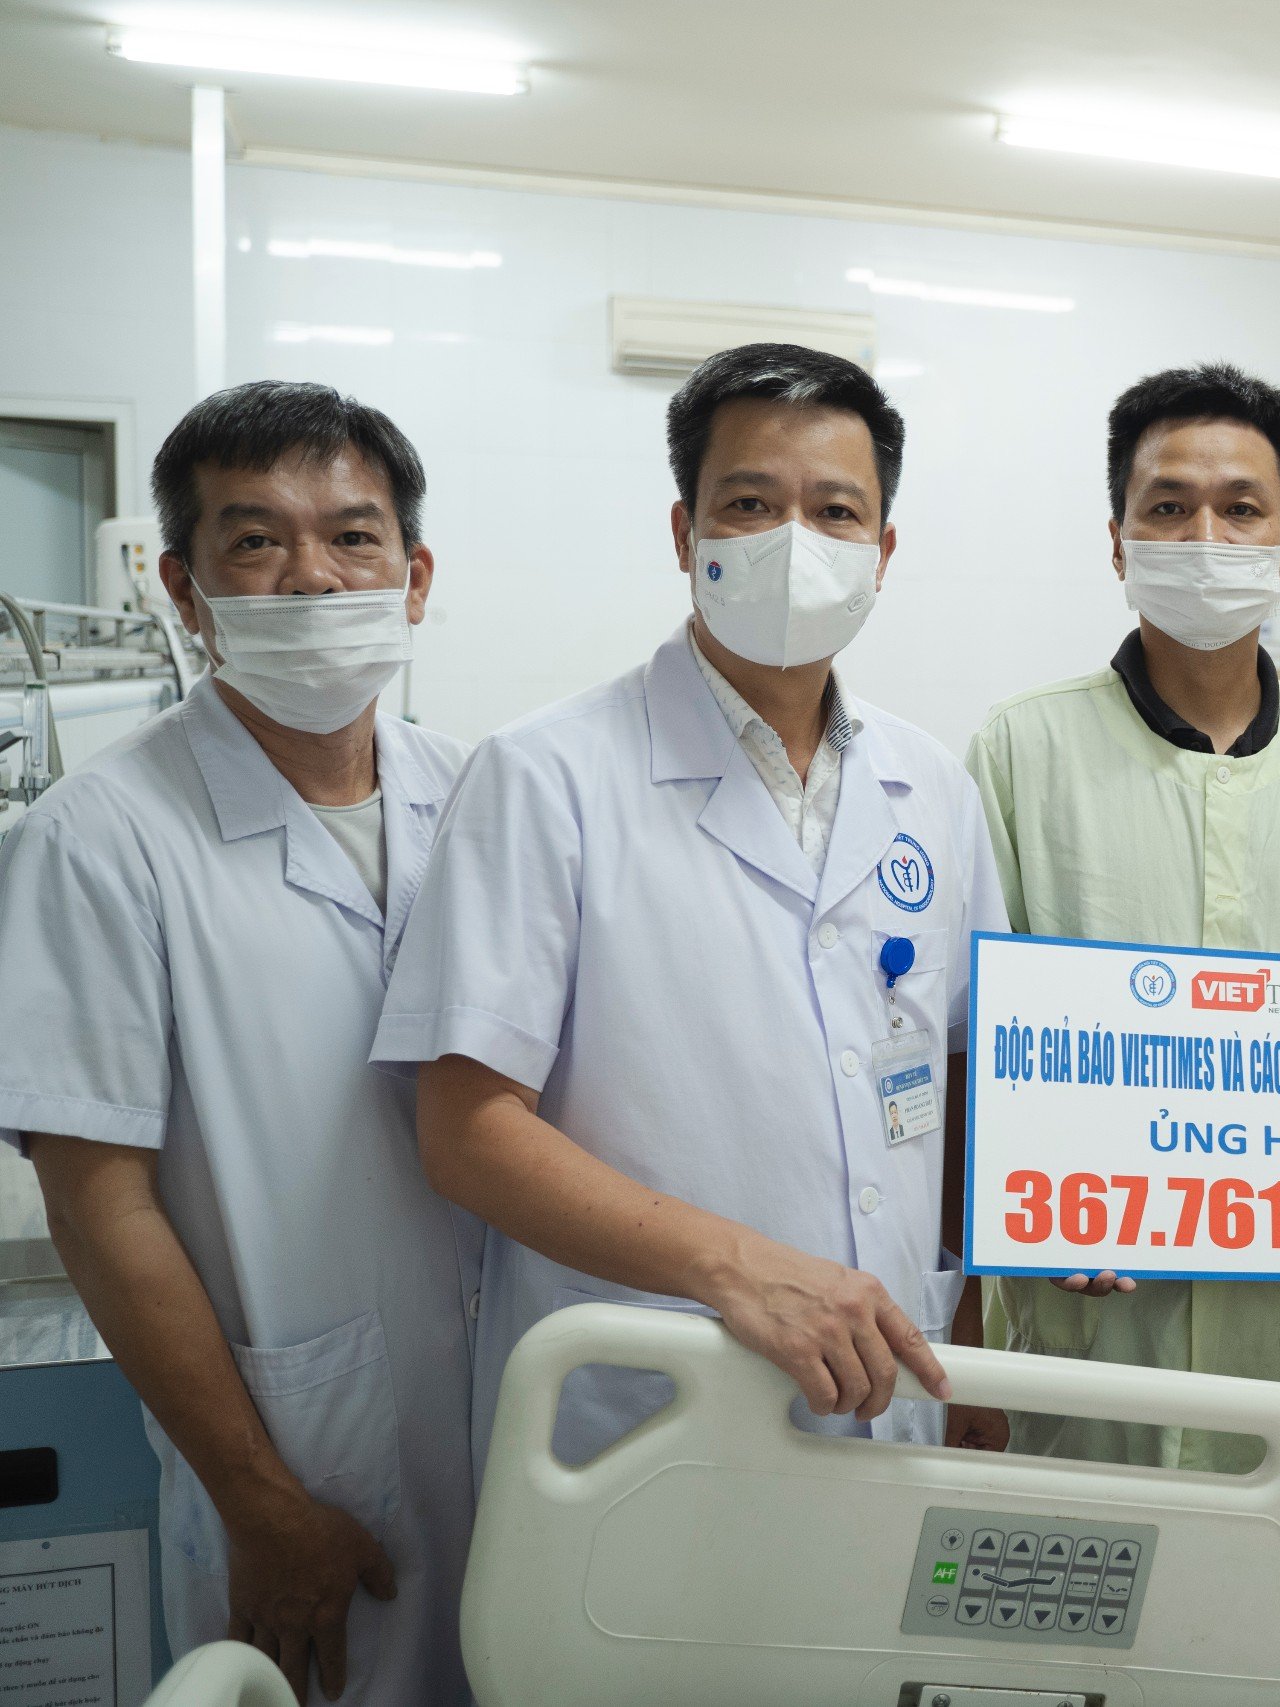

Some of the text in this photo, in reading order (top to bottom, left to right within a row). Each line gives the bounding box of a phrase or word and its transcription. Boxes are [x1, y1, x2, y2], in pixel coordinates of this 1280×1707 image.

[1198, 980, 1259, 1004] VIET
[994, 1016, 1034, 1091] ĐỘC
[1040, 1016, 1073, 1083] GIẢ
[1078, 1023, 1115, 1087] BÁO
[1121, 1033, 1215, 1092] VIETTIMES
[1220, 1030, 1246, 1093] VÀ
[1150, 1108, 1248, 1156] ỦNG
